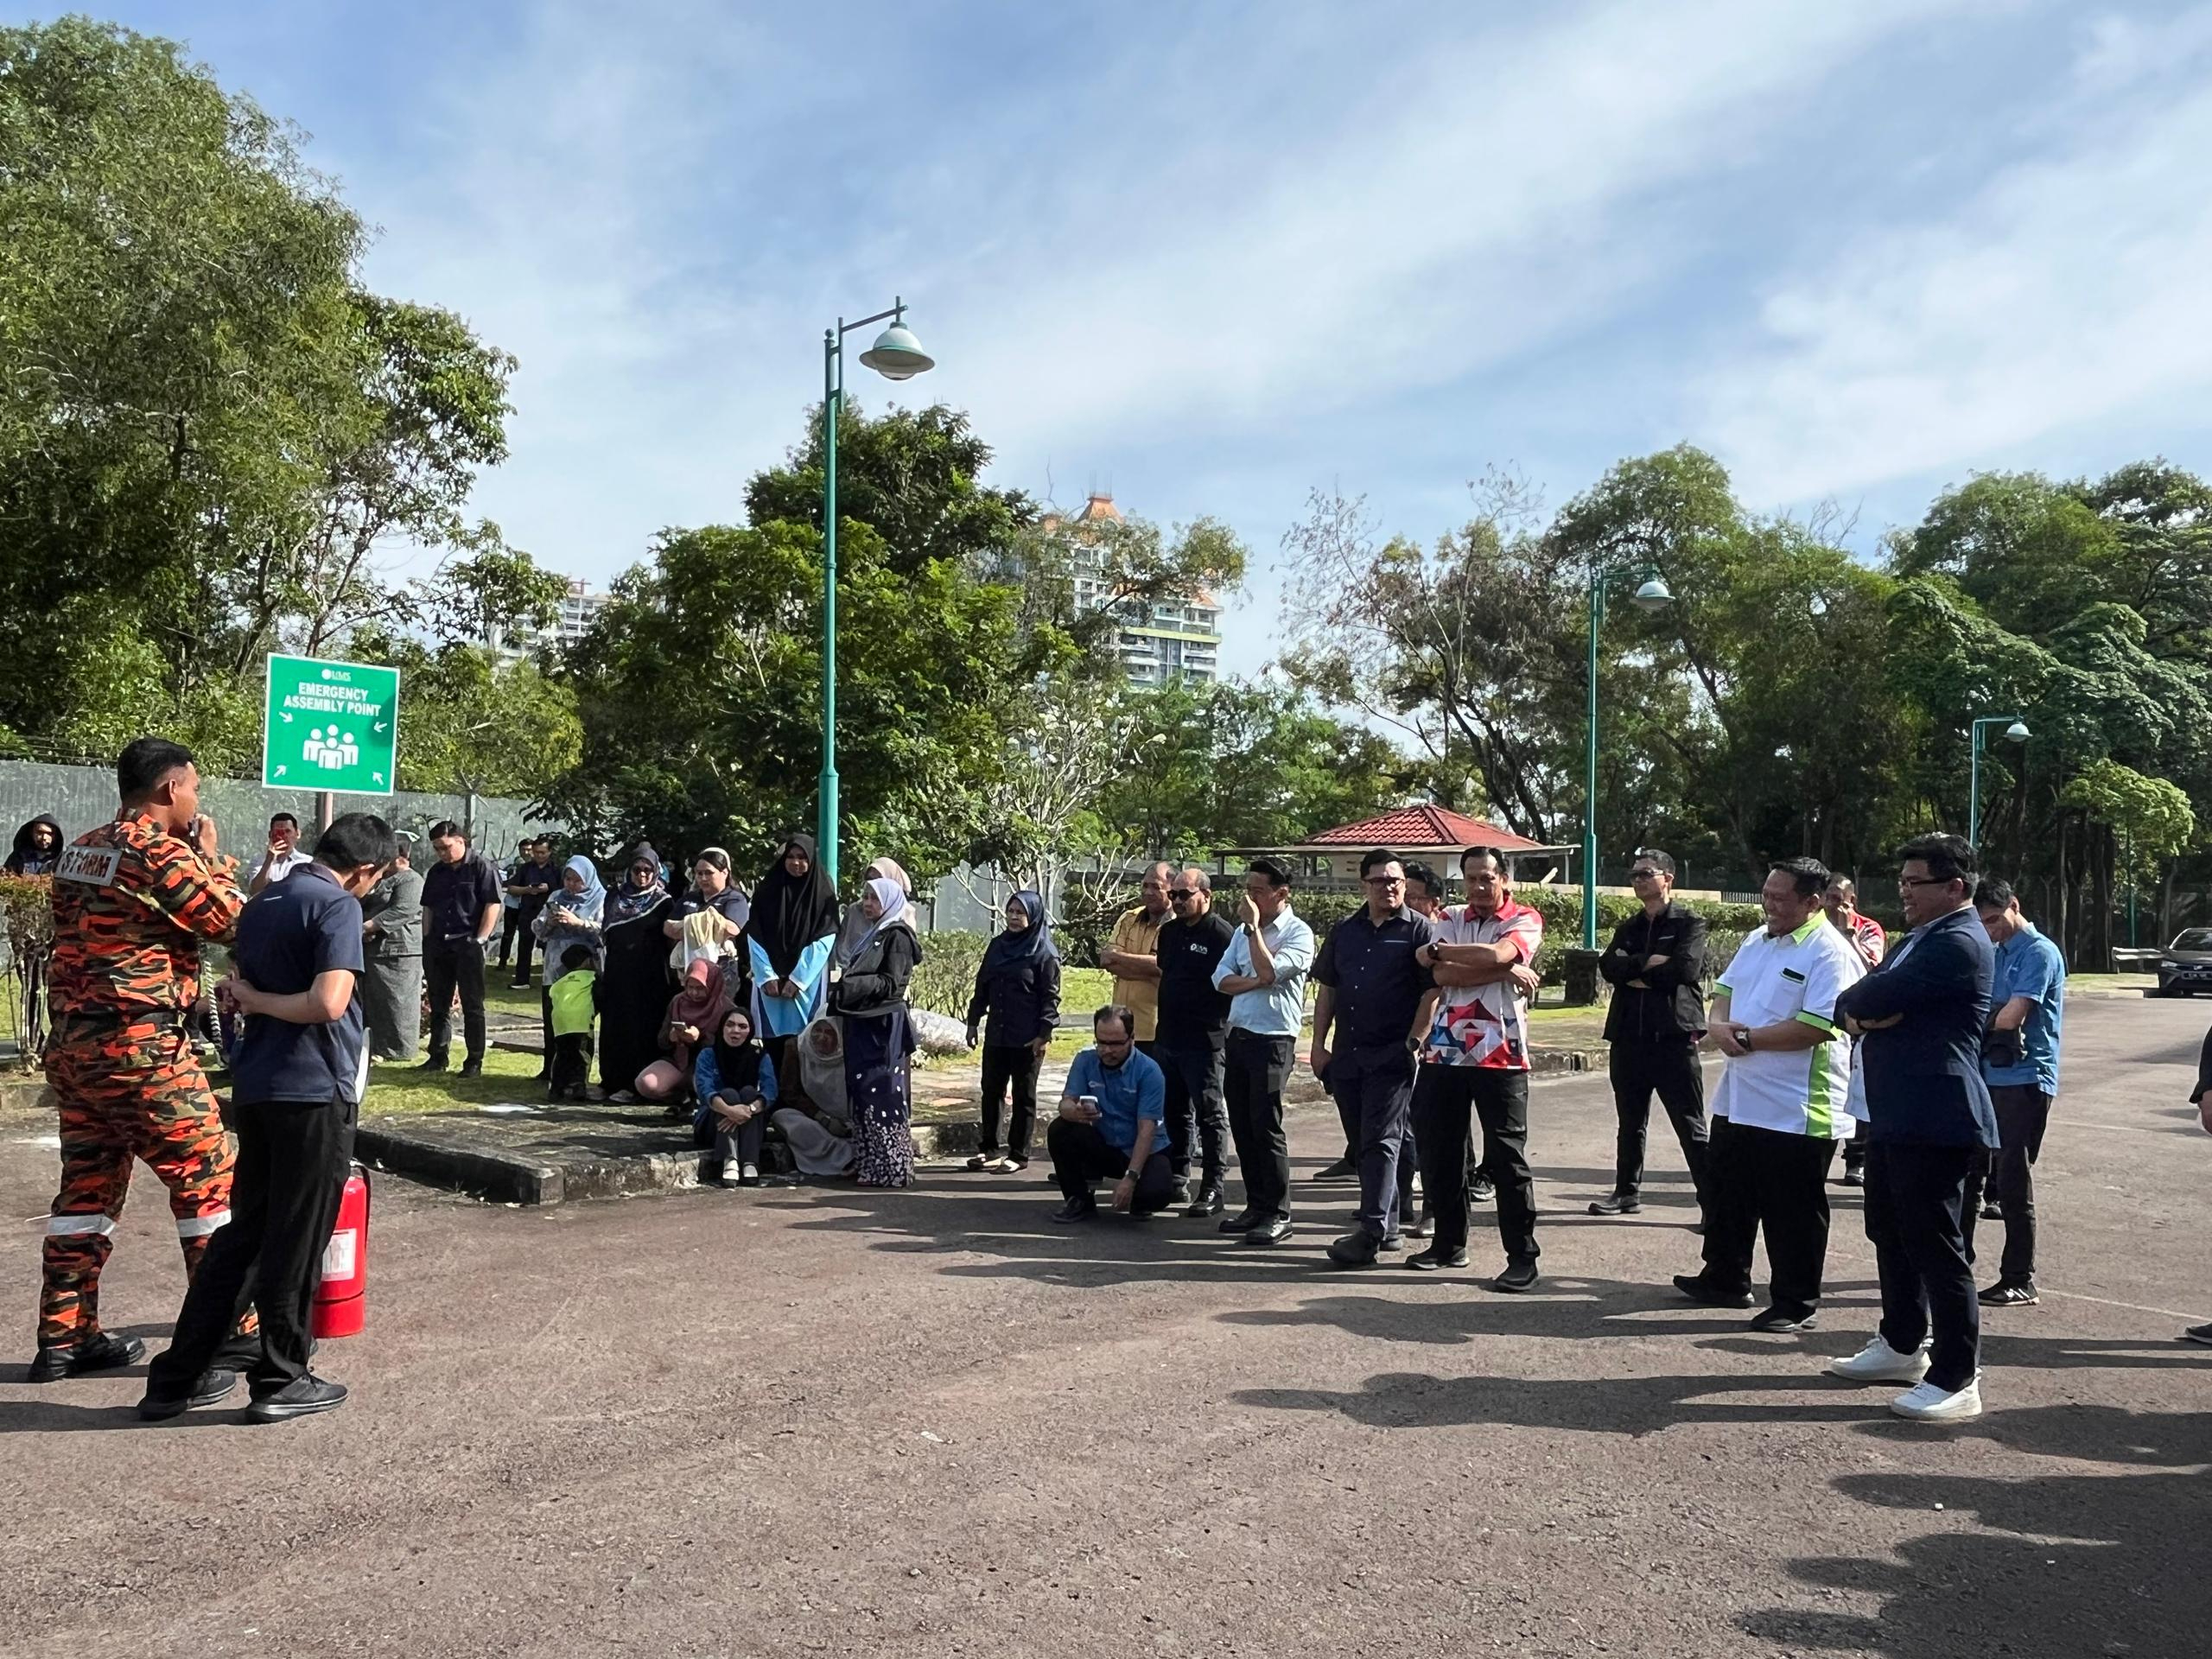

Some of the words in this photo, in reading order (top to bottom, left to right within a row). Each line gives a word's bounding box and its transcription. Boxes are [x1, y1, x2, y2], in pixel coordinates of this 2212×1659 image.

[298, 682, 368, 702] EMERGENCY
[283, 695, 345, 713] ASSEMBLY
[346, 702, 381, 716] POINT
